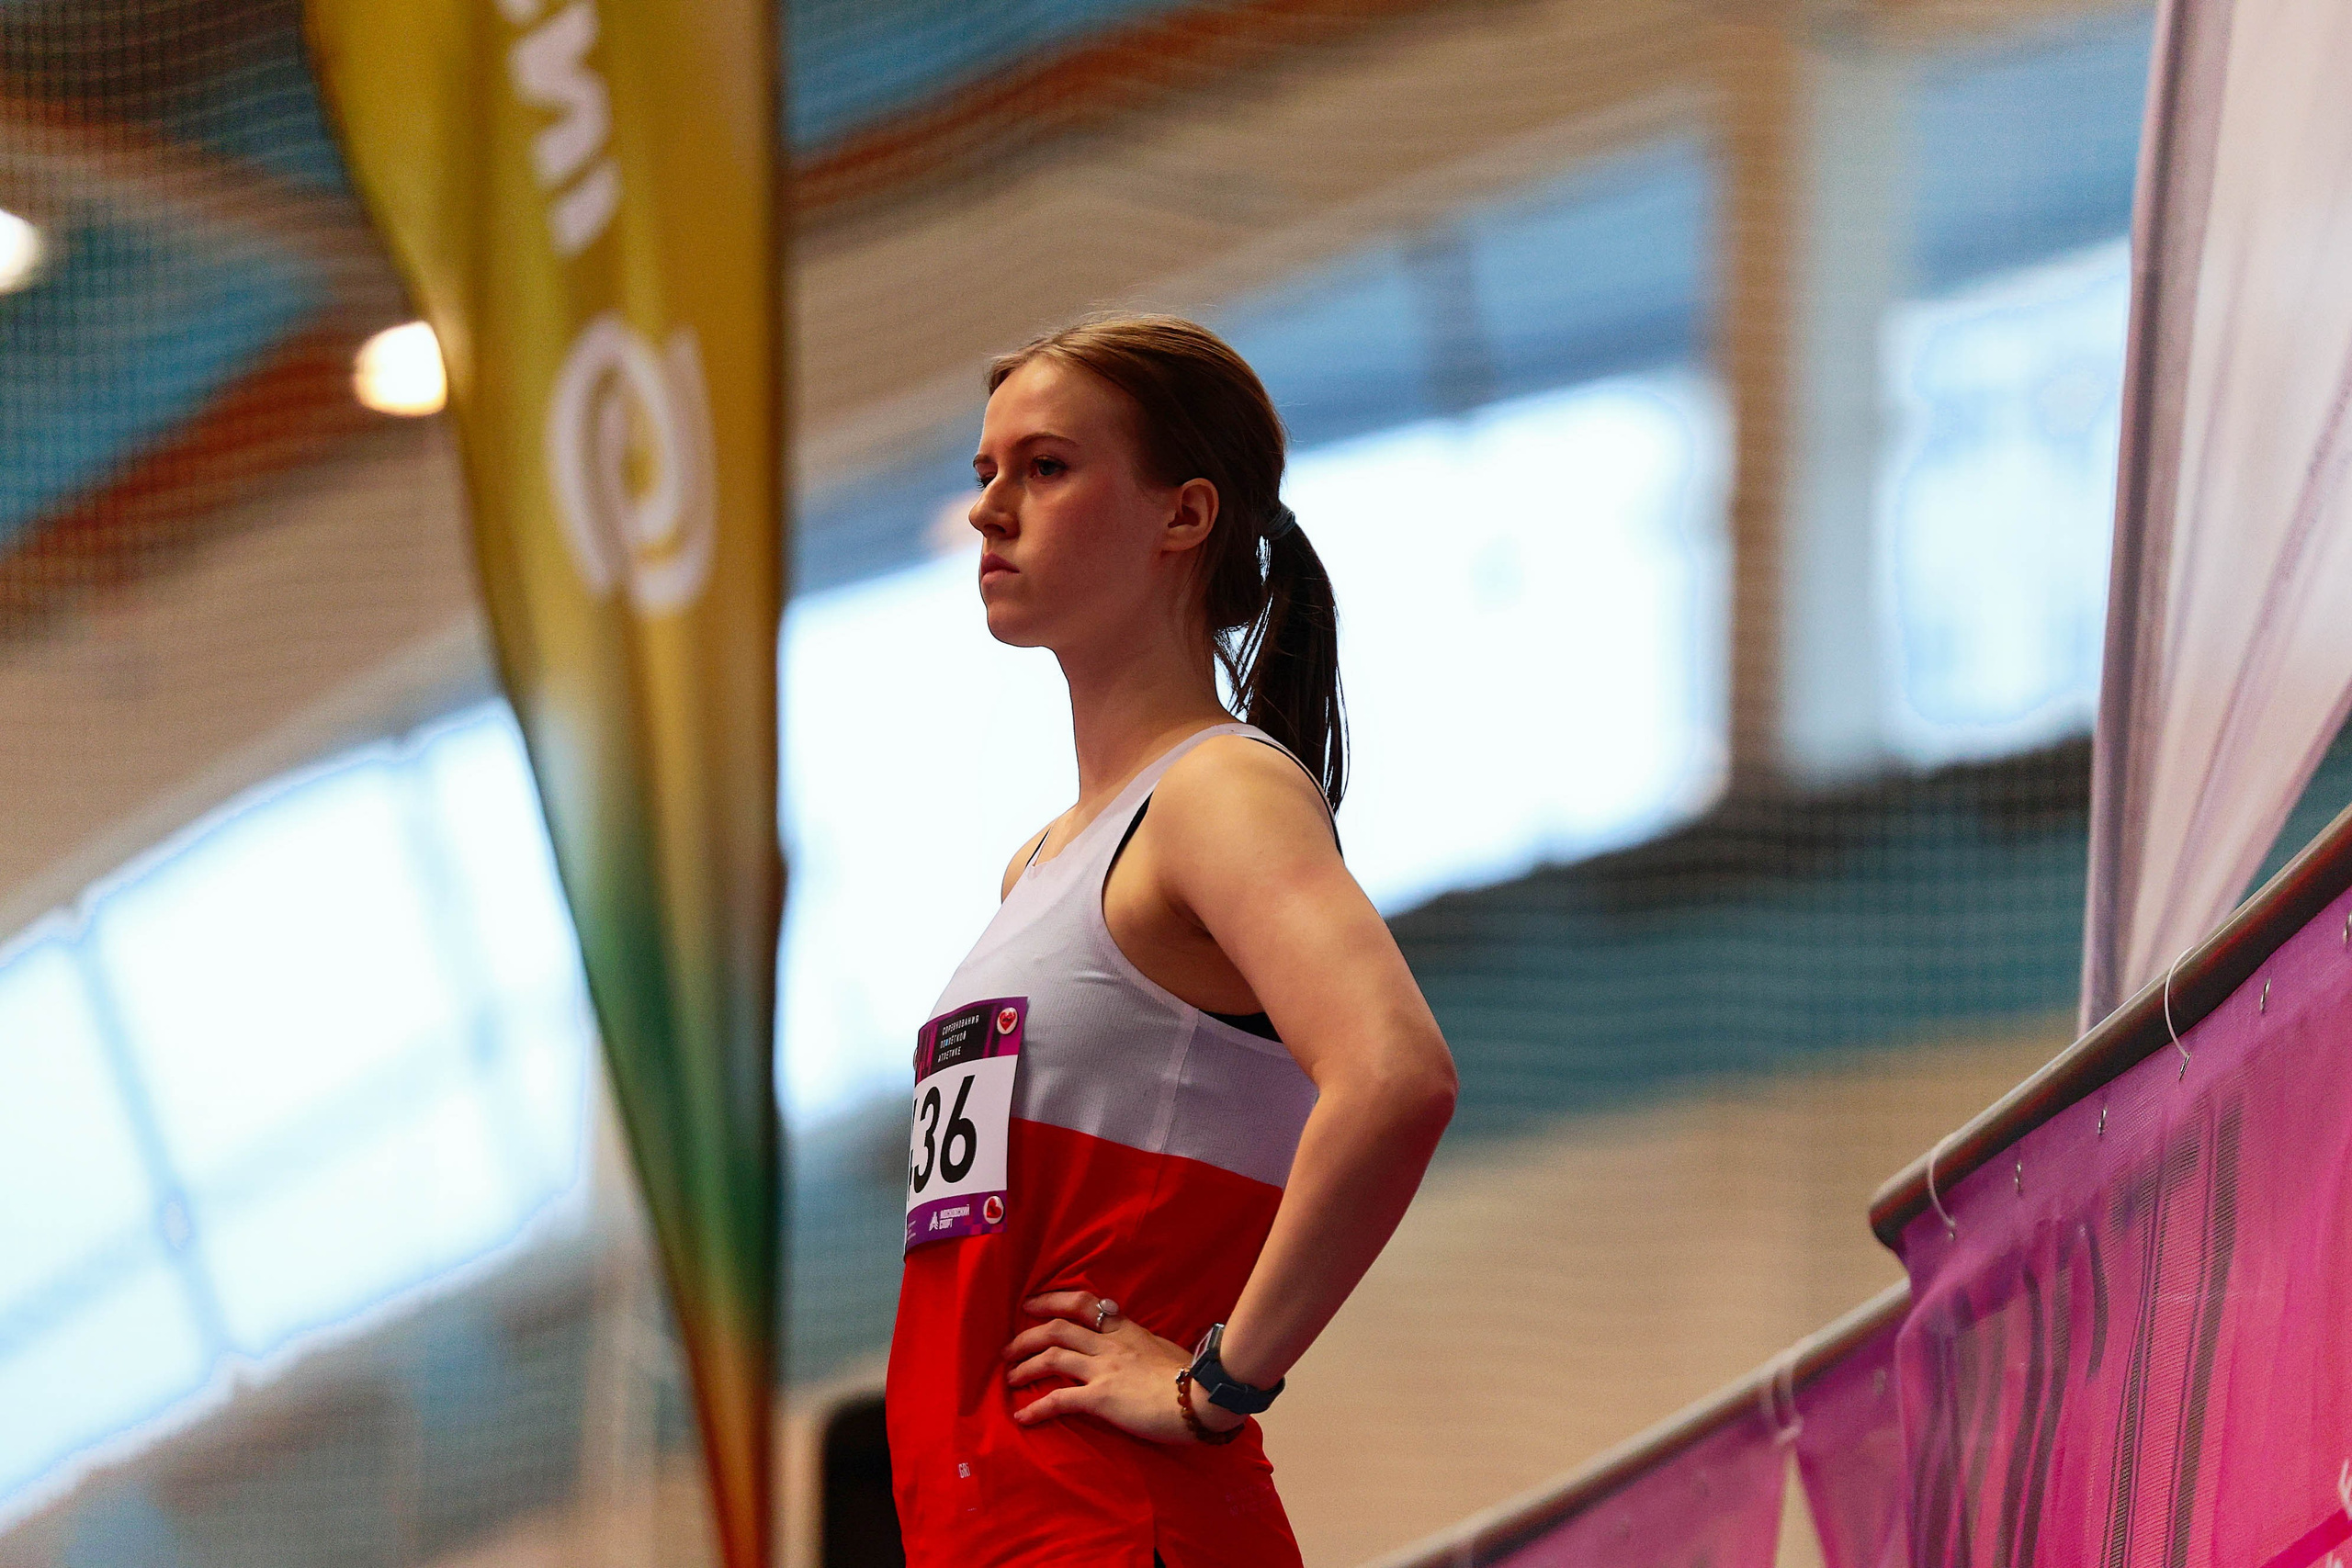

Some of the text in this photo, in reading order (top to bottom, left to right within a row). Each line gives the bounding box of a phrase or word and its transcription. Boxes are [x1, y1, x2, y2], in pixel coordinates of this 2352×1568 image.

[942, 1014, 979, 1036] СОРЕВНОВАНИЯ
[937, 1046, 962, 1063] АТЛЕТИКЕ
[908, 1075, 977, 1201] 36
